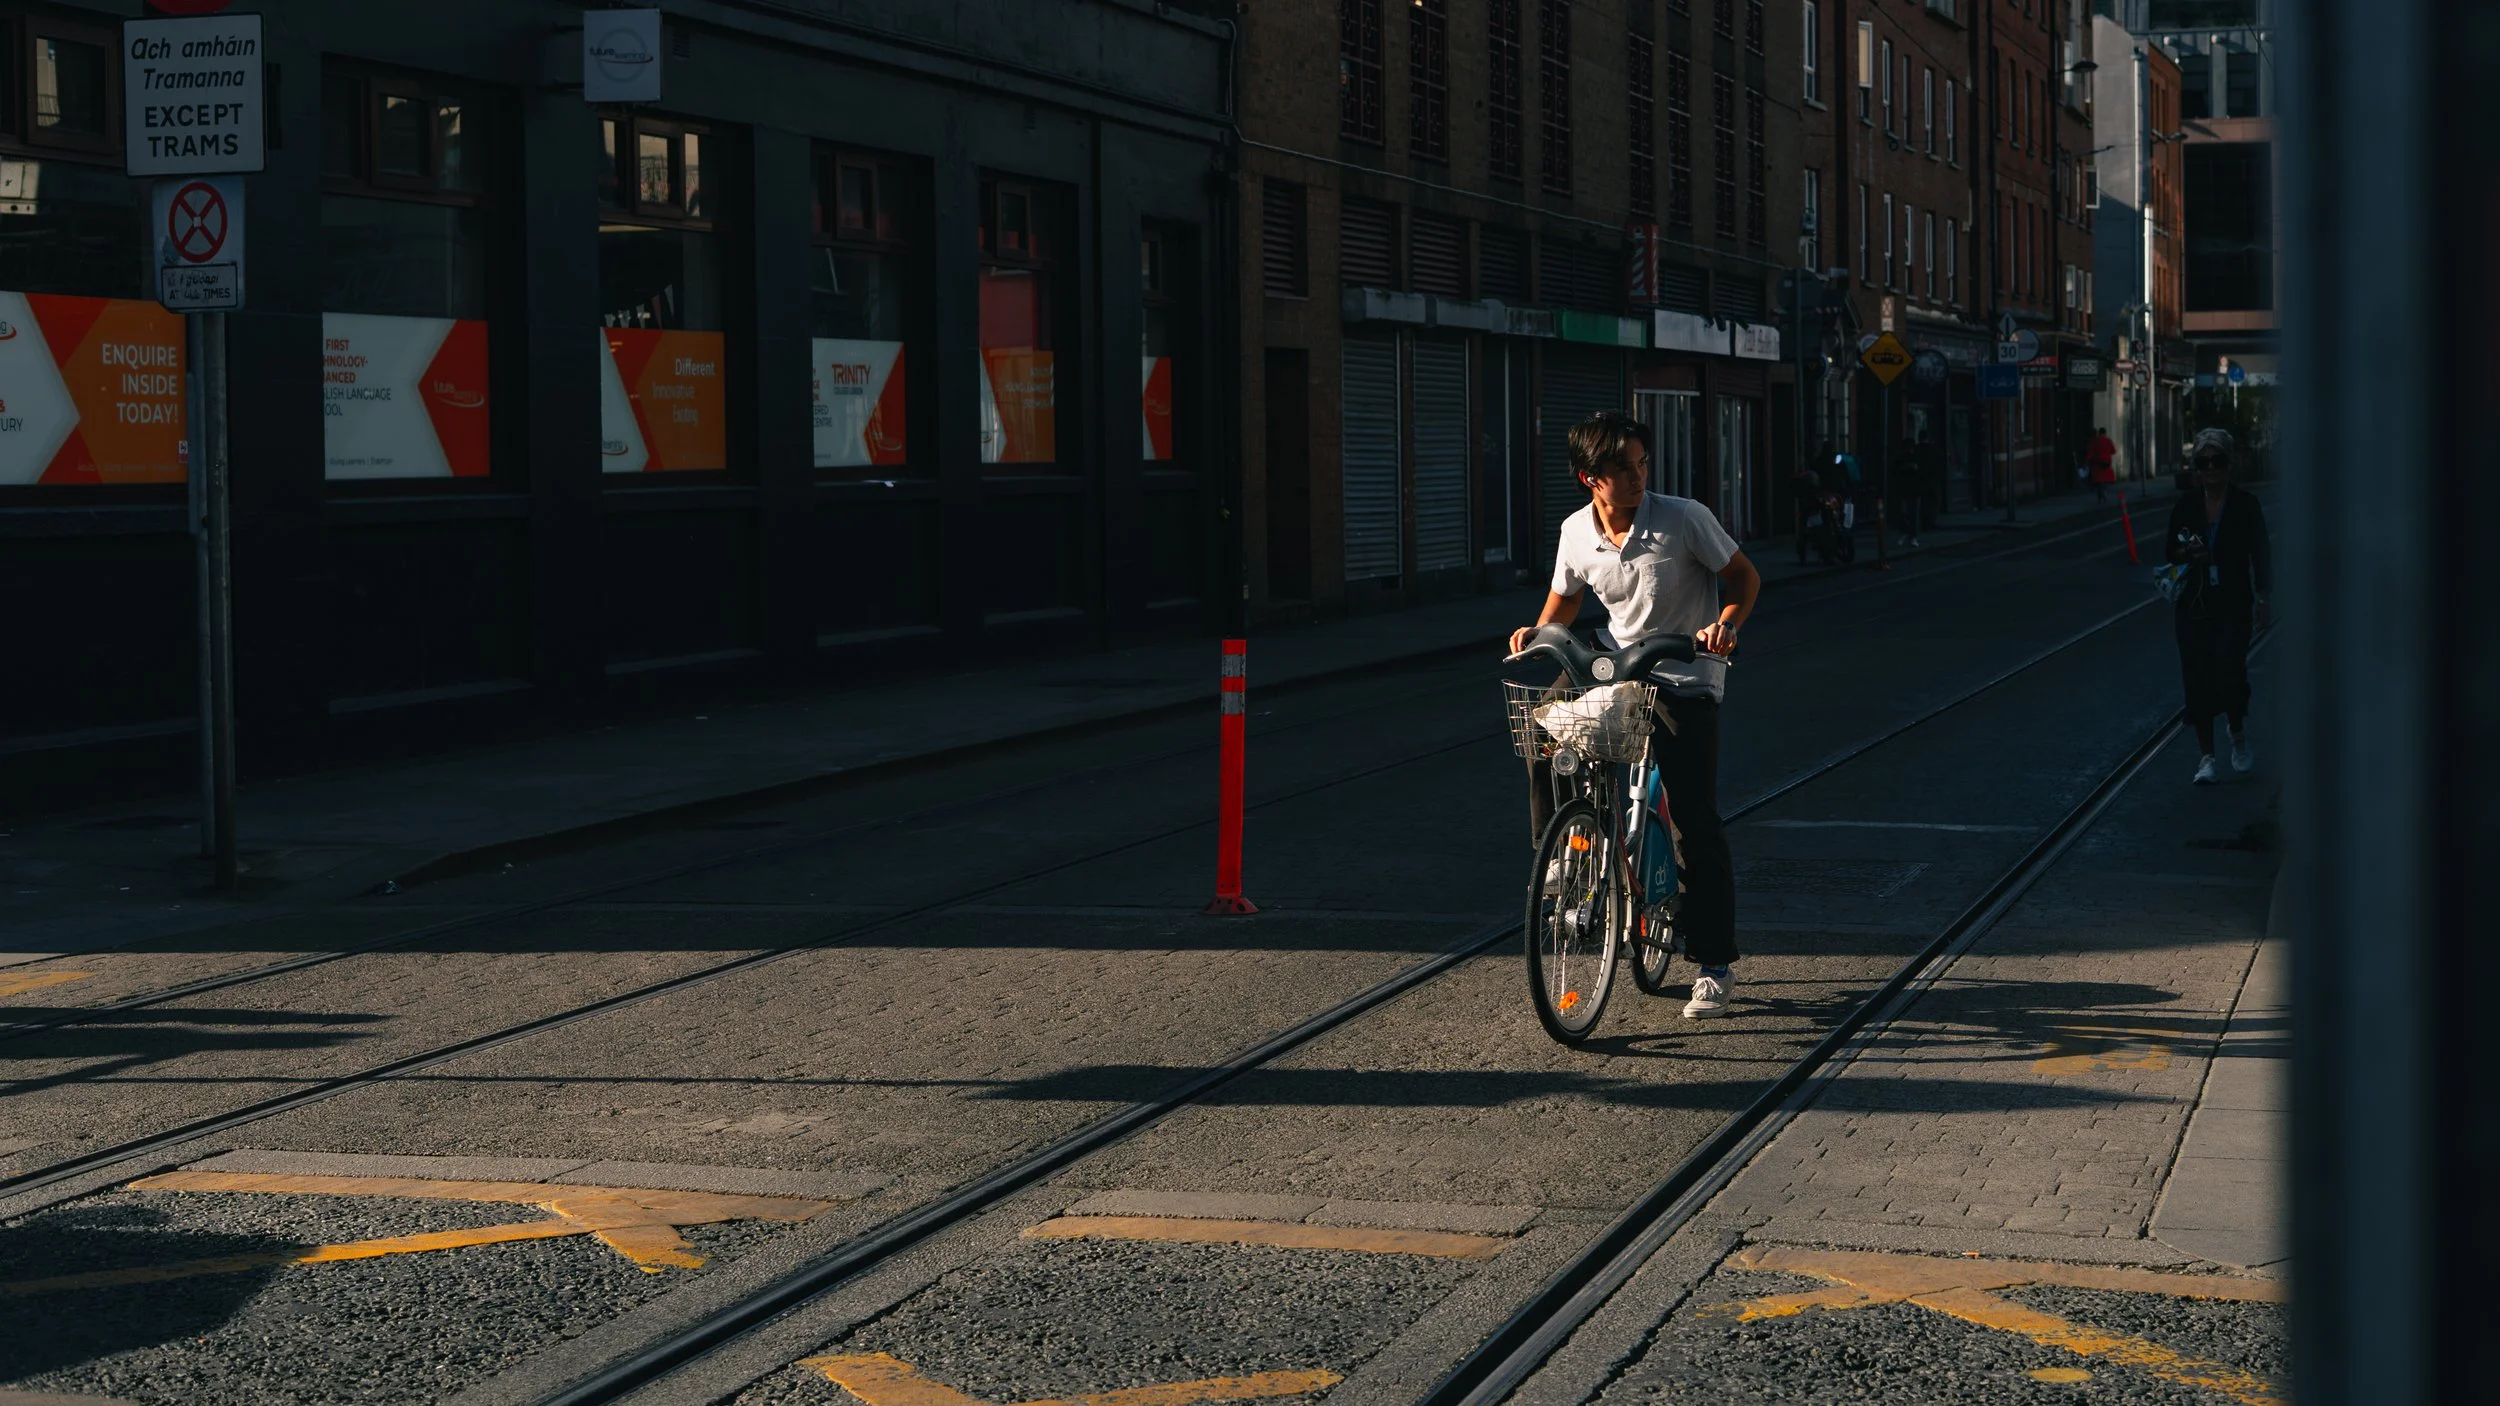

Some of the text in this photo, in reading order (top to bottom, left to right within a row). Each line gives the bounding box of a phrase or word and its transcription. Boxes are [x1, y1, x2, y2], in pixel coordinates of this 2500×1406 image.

[131, 37, 171, 60] Ach
[143, 68, 245, 90] Tramanna
[144, 102, 244, 128] EXCEPT
[147, 133, 239, 158] TRAMS
[203, 287, 231, 299] TIMES
[325, 338, 350, 351] FIRST
[2000, 346, 2017, 359] 30
[102, 343, 178, 370] ENQUIRE
[674, 357, 716, 376] Different
[122, 373, 178, 396] INSIDE
[831, 363, 872, 385] TRINITY
[346, 387, 392, 401] LANGUAGE
[116, 402, 179, 424] TODAY!
[0, 417, 24, 432] URY
